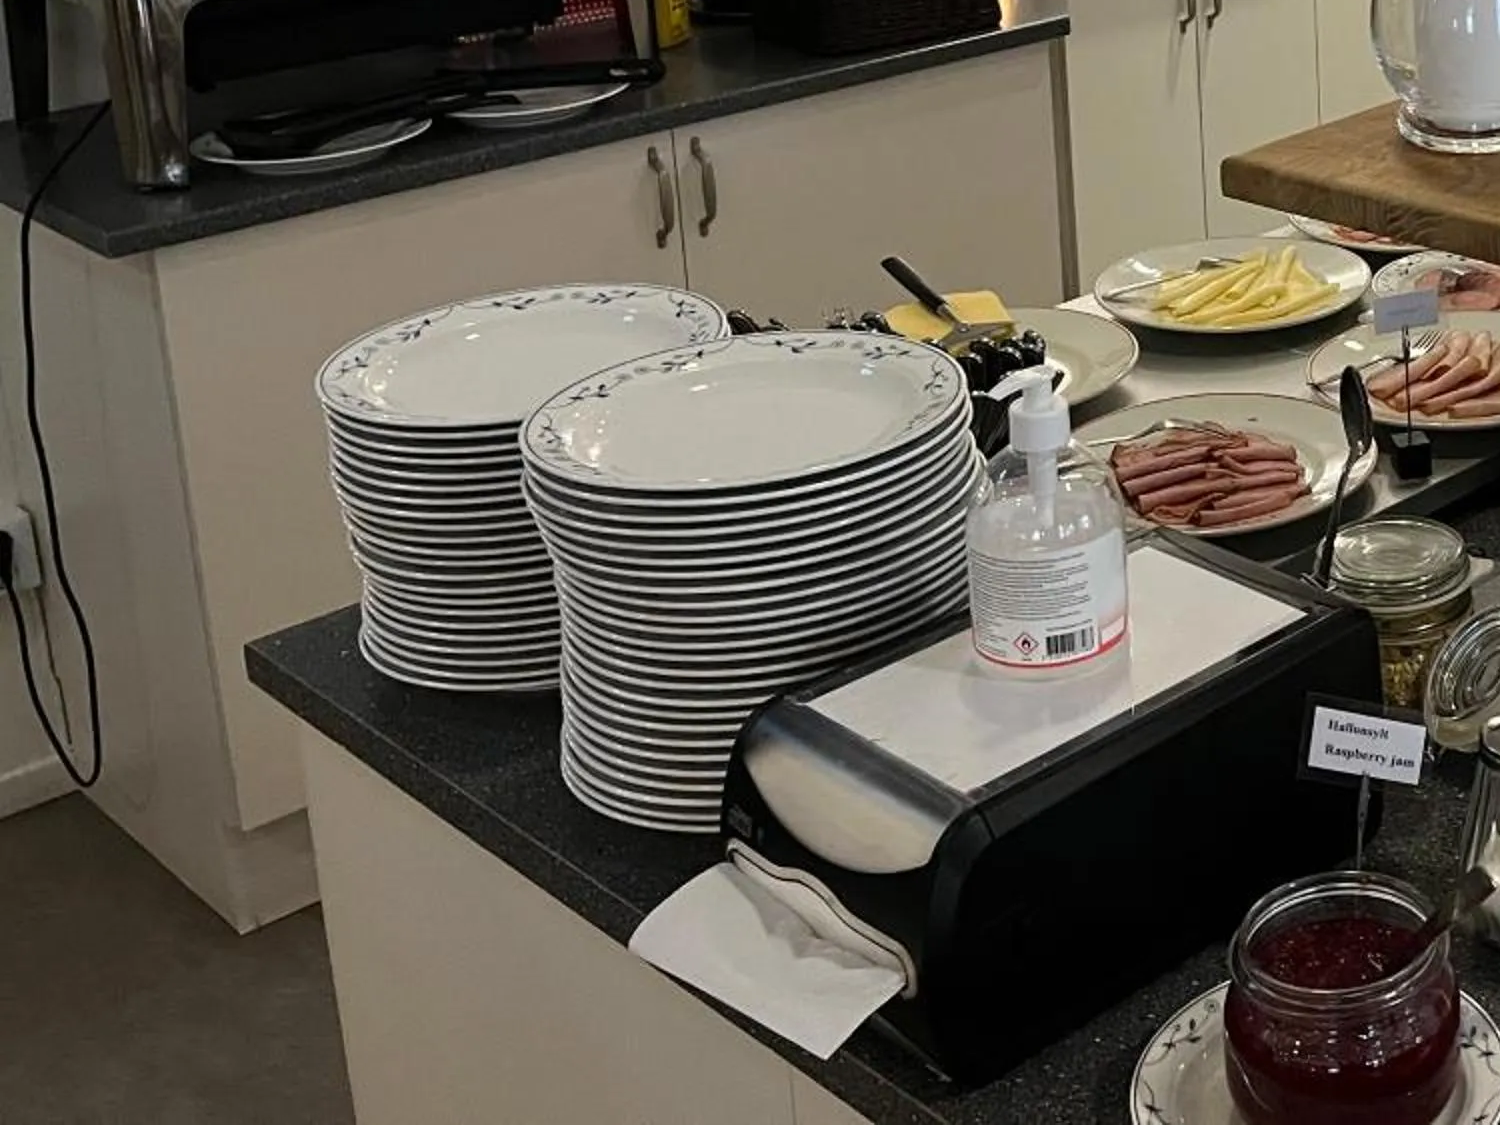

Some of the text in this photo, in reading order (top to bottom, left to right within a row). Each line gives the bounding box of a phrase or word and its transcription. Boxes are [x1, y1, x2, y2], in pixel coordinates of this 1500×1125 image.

[1327, 718, 1389, 740] Hallonsylt
[1324, 742, 1416, 768] Raspberry jam
